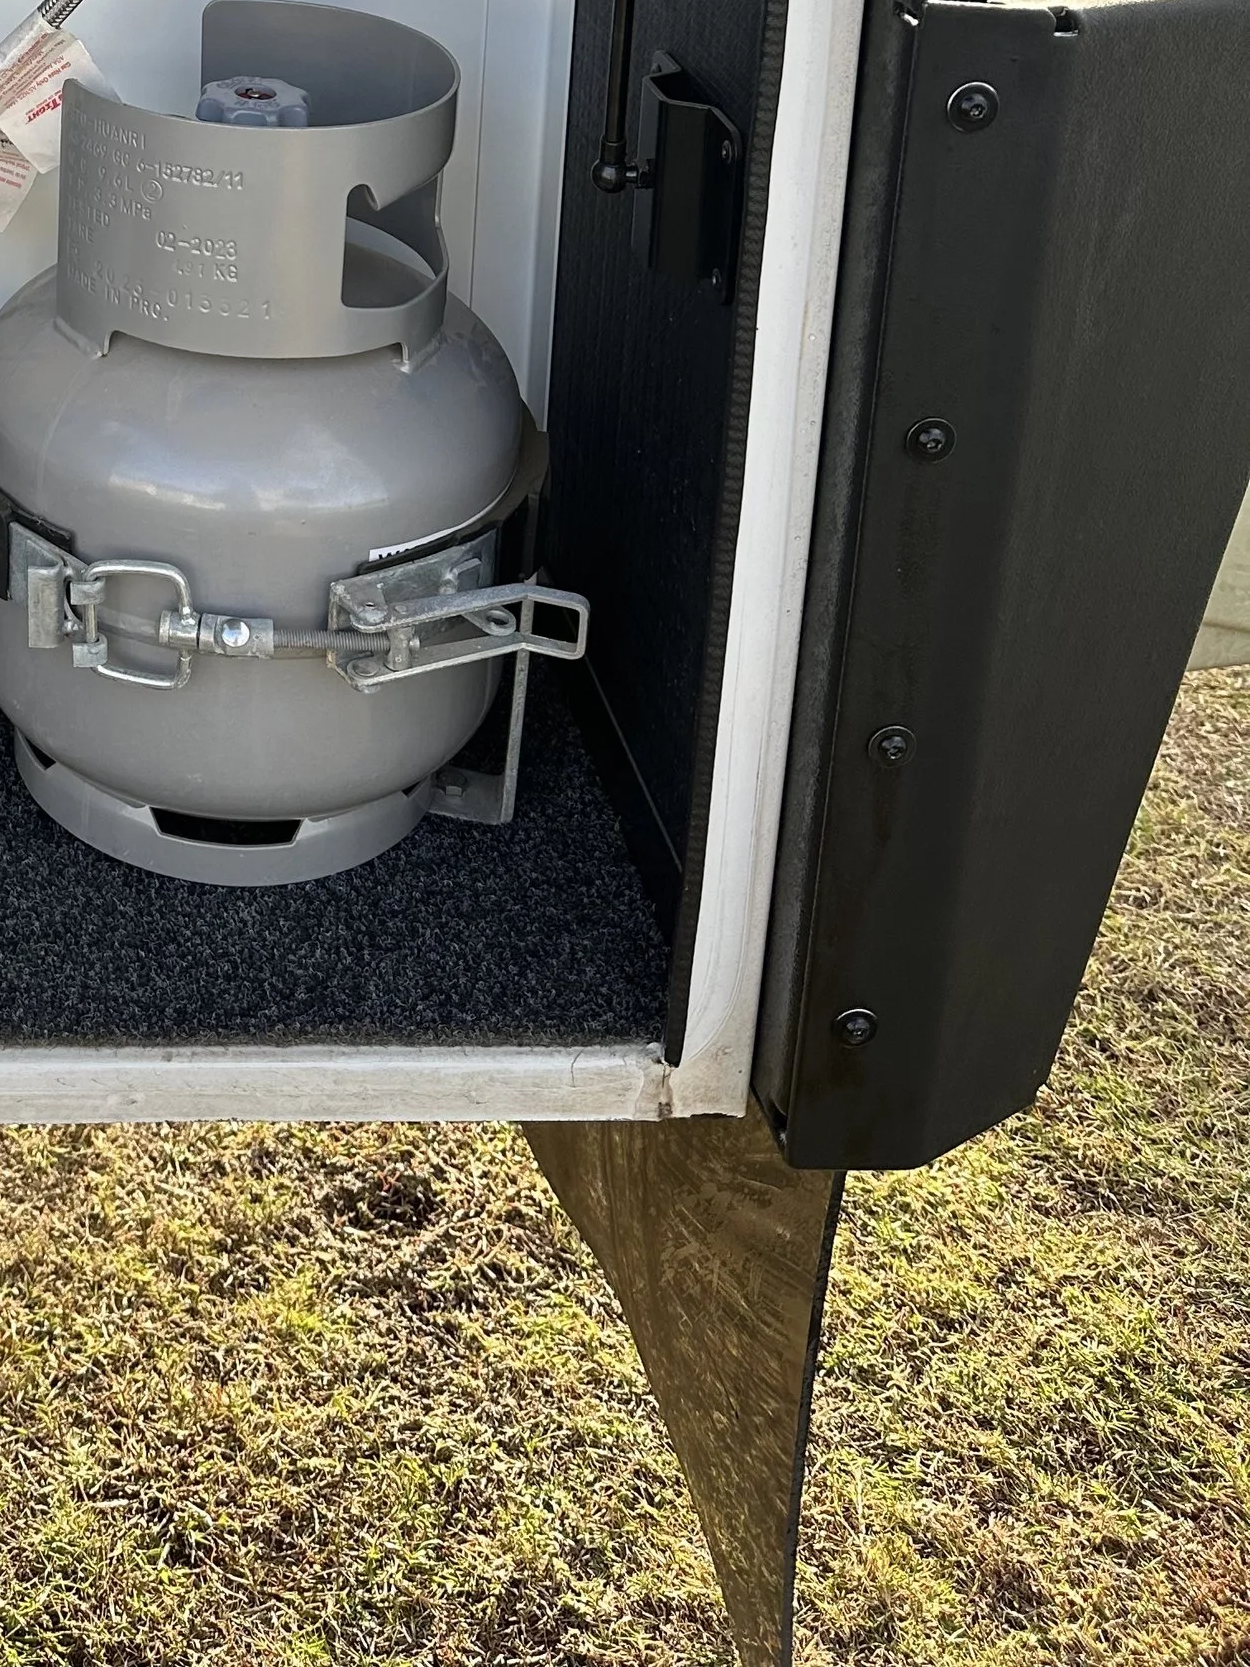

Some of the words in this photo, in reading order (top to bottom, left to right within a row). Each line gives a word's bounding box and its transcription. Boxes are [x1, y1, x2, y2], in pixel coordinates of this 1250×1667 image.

[155, 231, 238, 260] 02-2023
[213, 263, 239, 283] KG
[104, 285, 121, 305] IN
